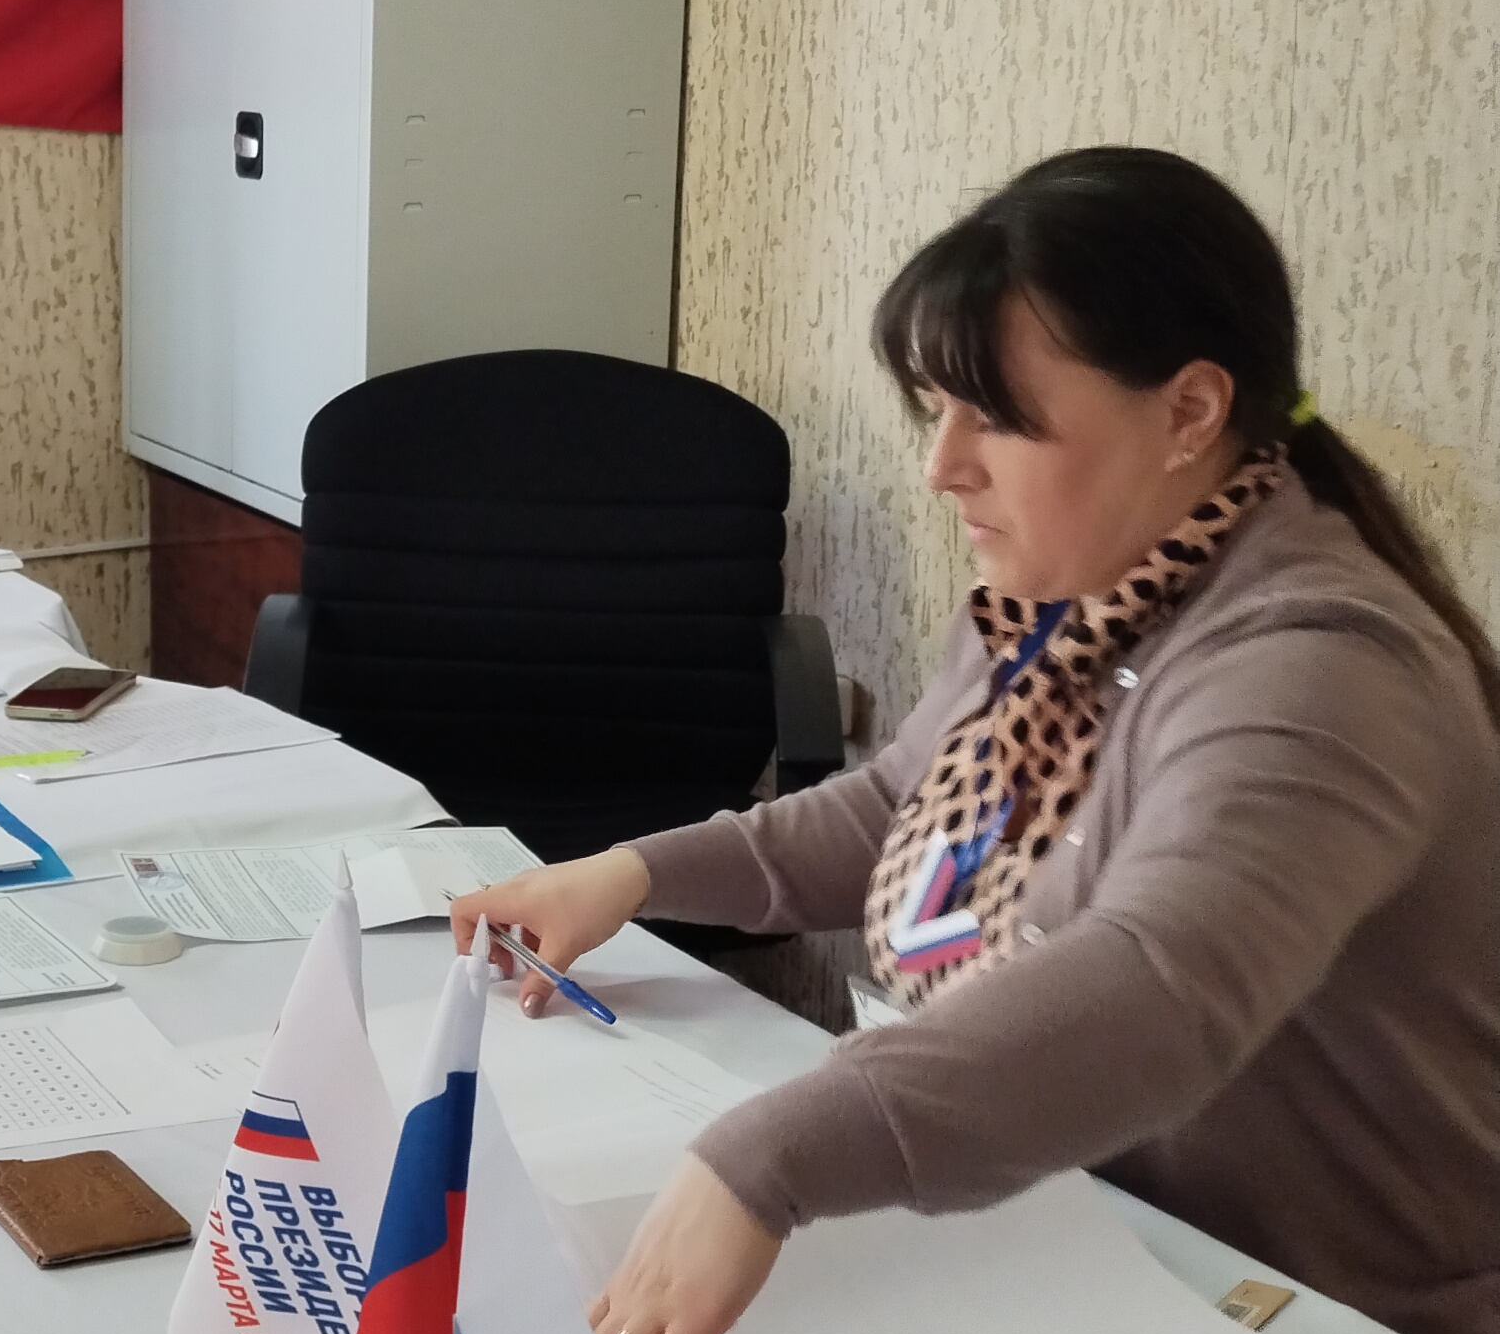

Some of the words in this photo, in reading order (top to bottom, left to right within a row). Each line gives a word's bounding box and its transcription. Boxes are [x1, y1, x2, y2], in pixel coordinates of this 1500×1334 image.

[209, 1210, 225, 1236] 17
[225, 1169, 298, 1314] РОССИИ
[299, 1184, 370, 1322] ВЫБО
[209, 1240, 260, 1327] МАРТА
